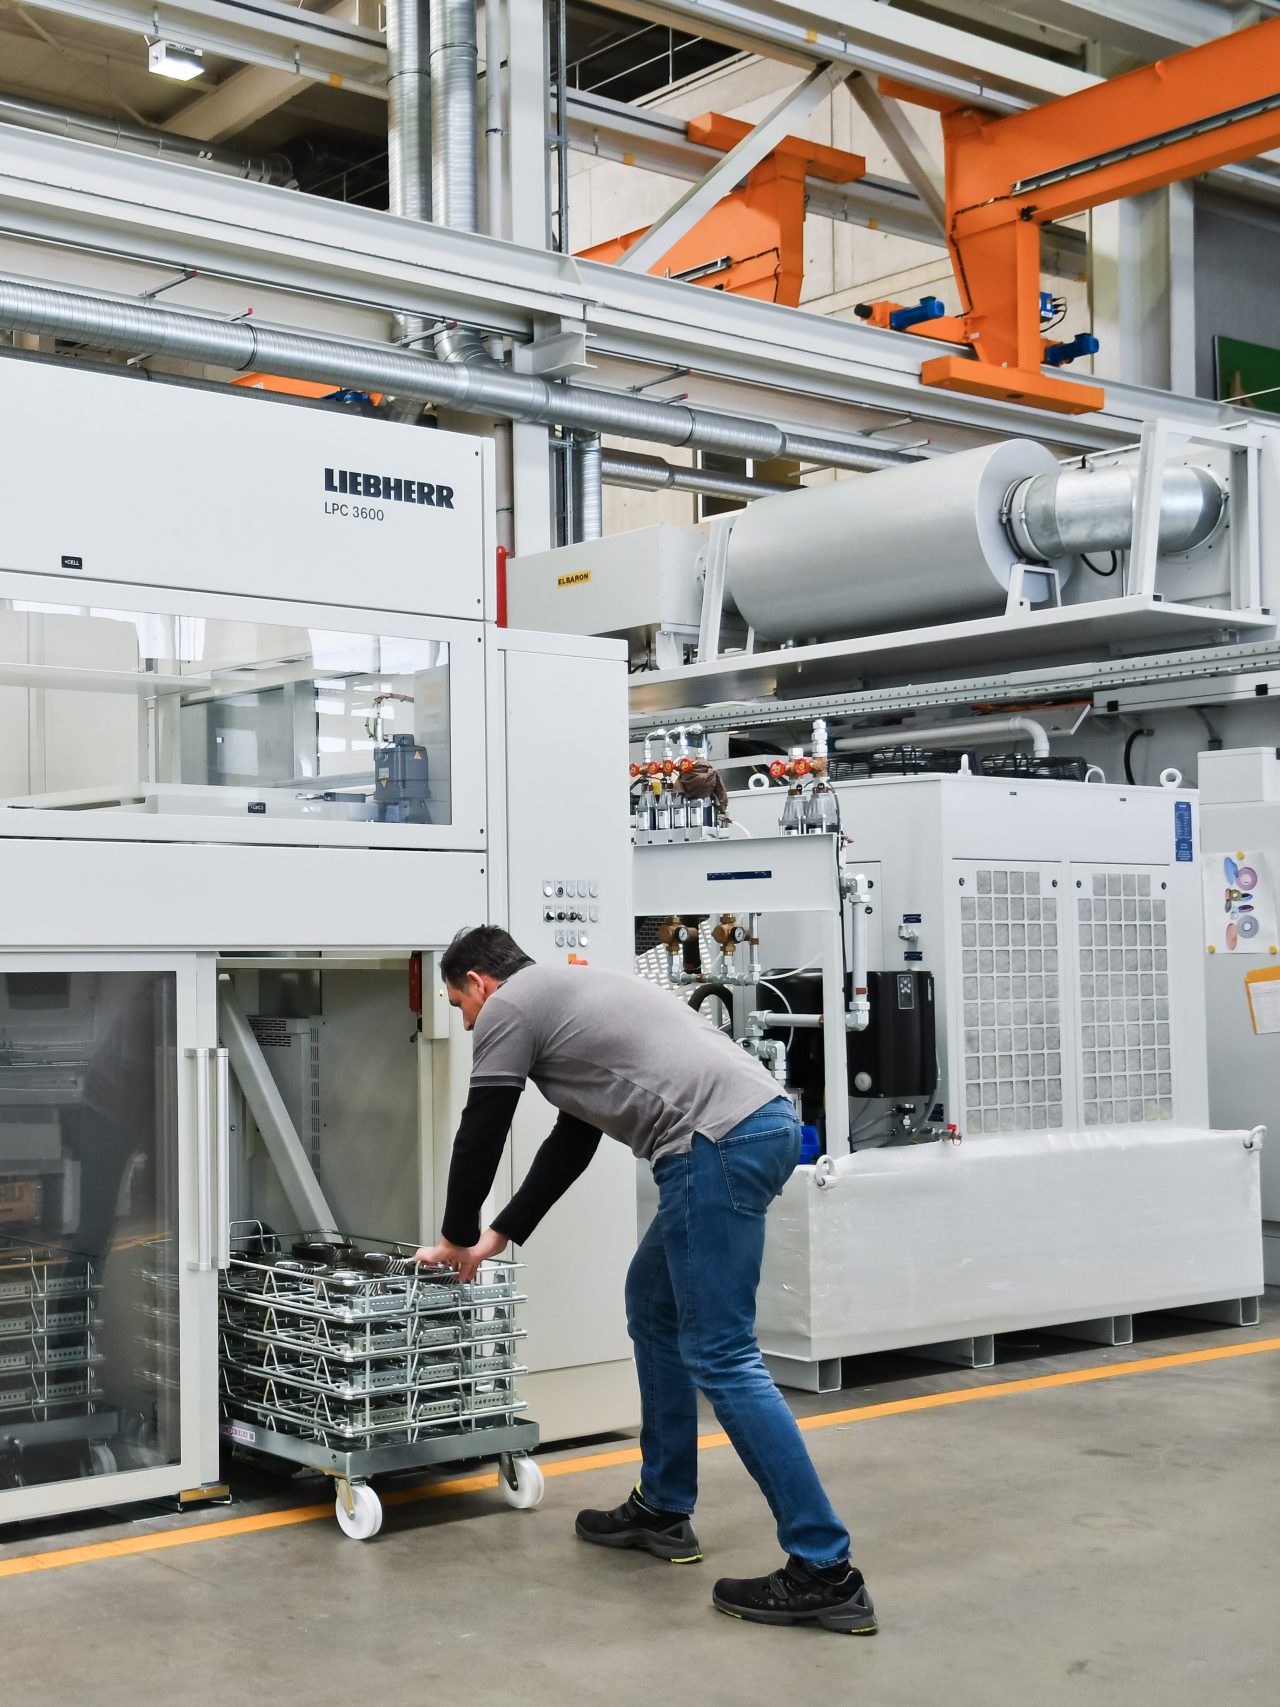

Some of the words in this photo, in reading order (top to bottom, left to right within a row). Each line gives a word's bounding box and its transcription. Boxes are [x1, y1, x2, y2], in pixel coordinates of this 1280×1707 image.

[325, 467, 454, 509] LIEBHERR
[325, 502, 348, 516] LPC
[352, 506, 384, 521] 3600
[557, 573, 589, 585] ELBARON
